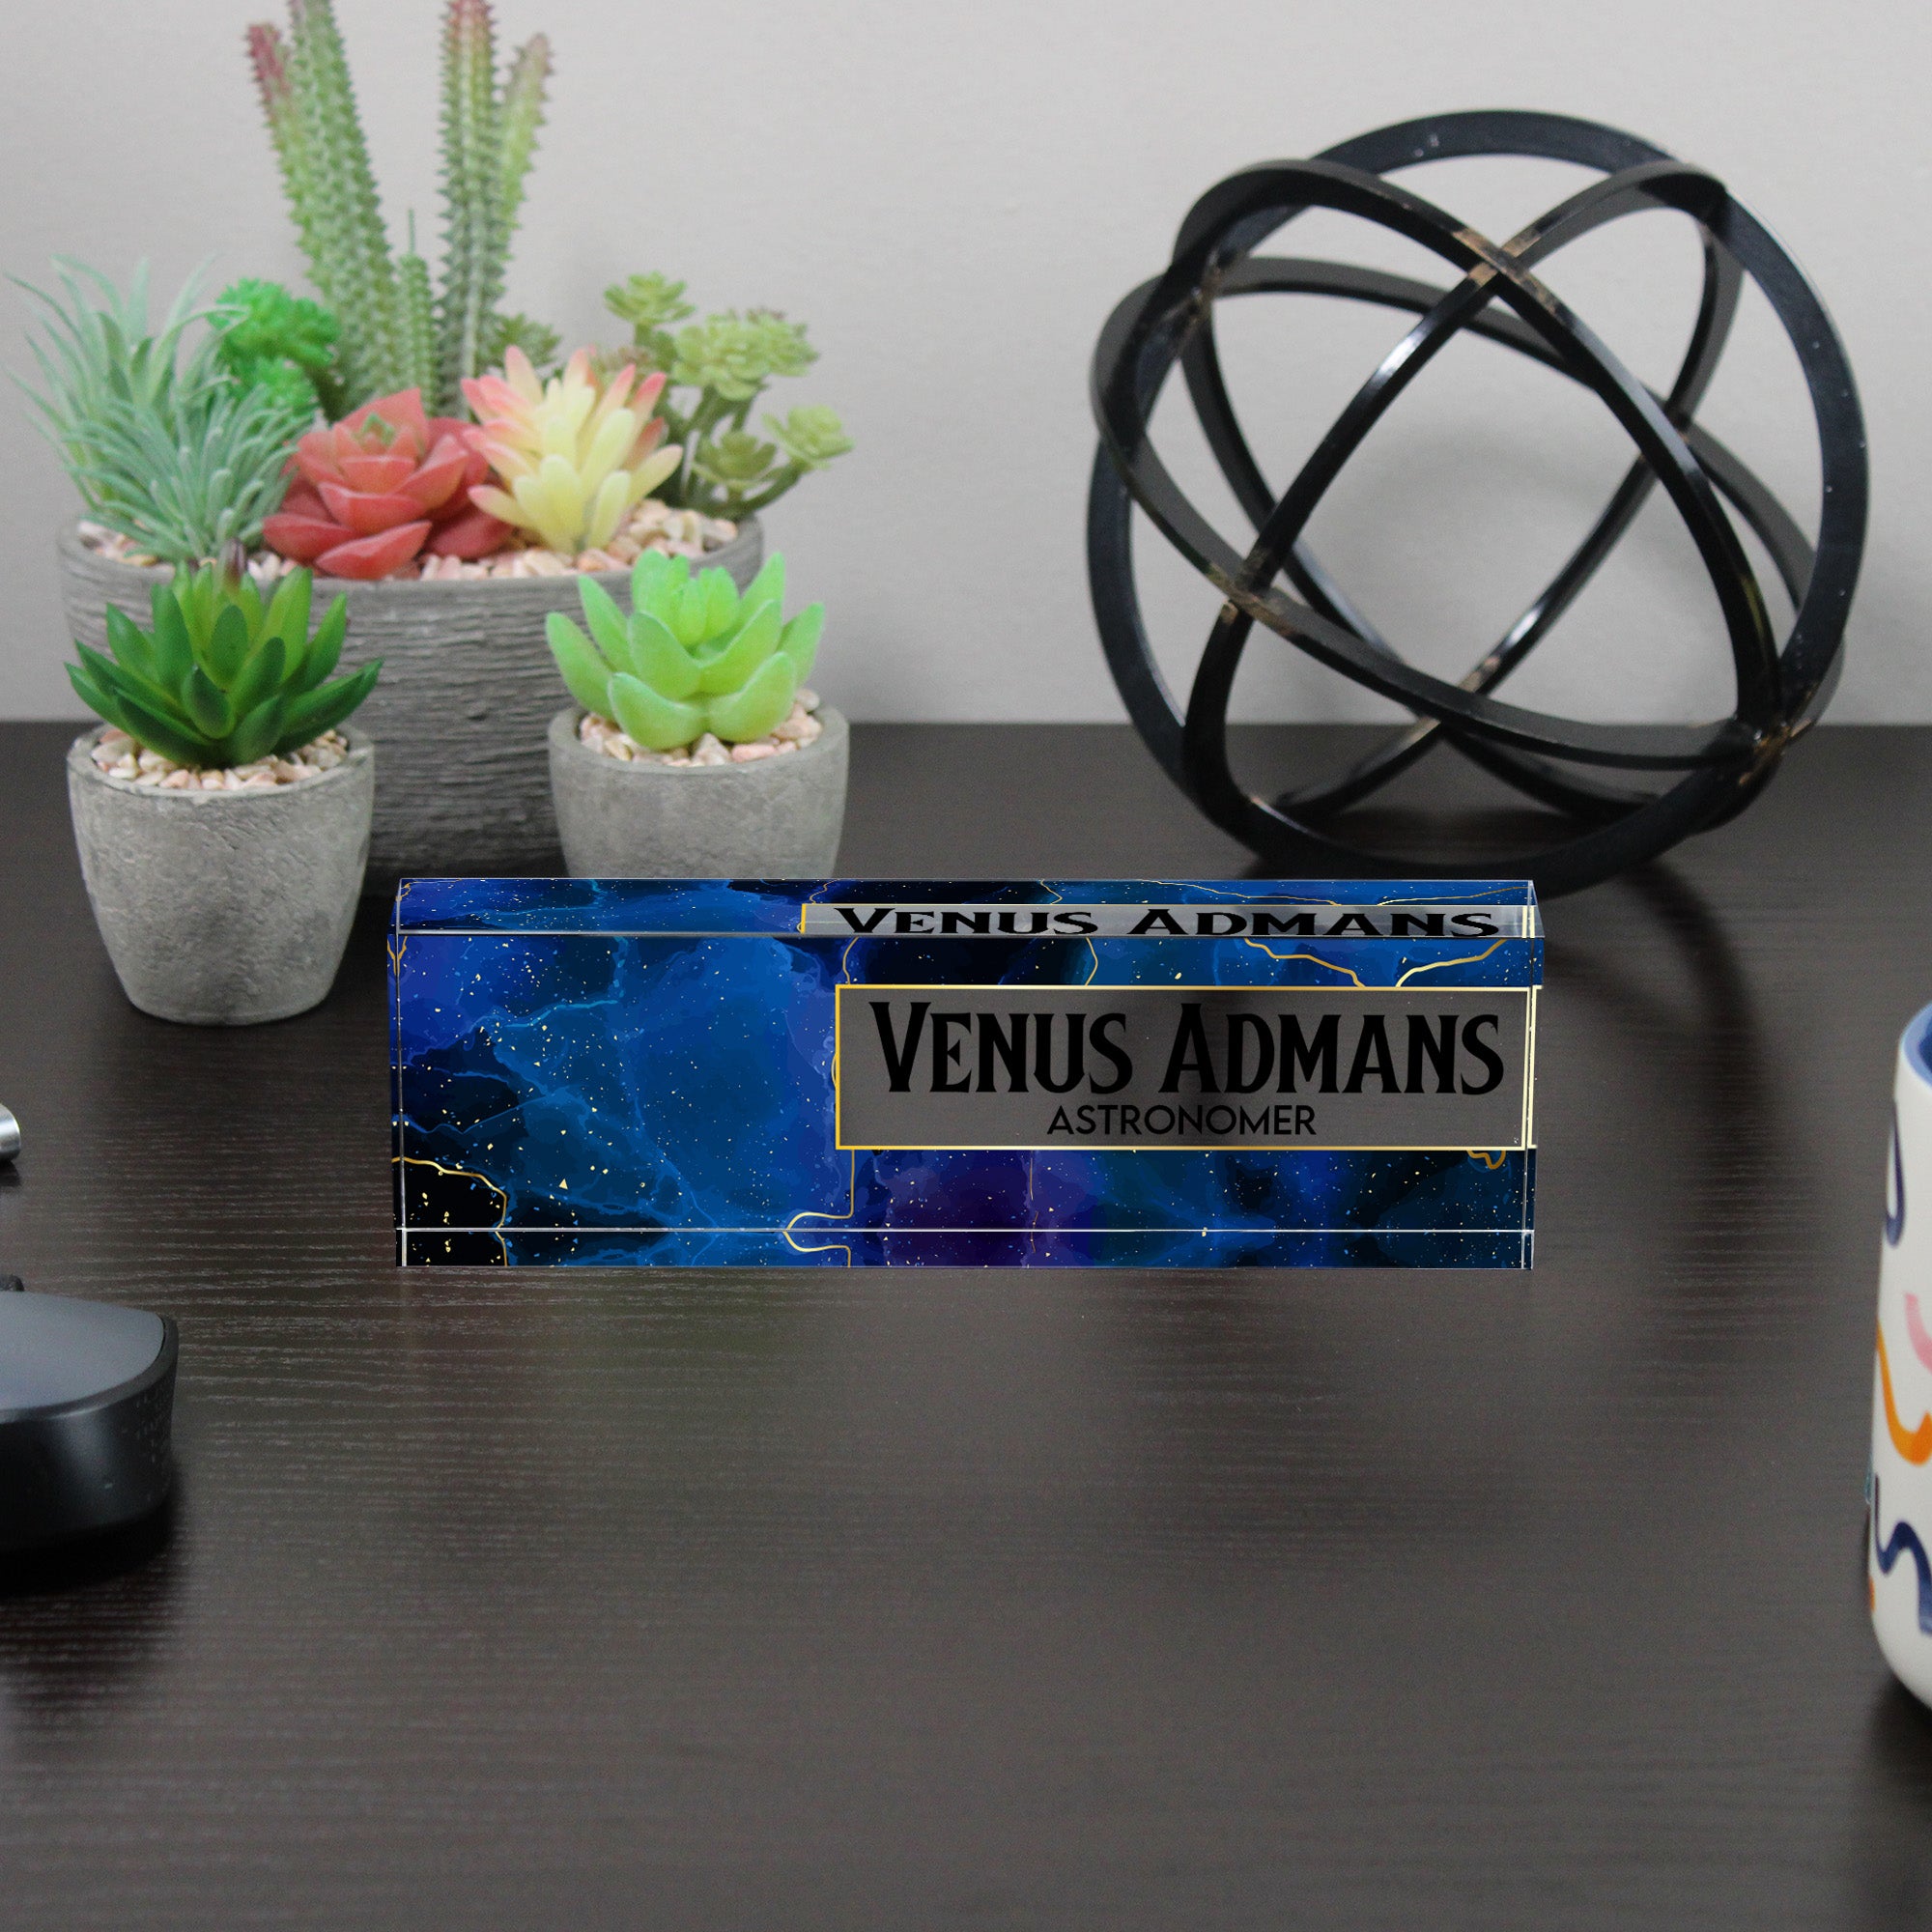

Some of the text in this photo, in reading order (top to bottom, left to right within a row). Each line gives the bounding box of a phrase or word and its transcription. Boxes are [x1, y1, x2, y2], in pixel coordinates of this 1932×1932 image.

[835, 907, 1500, 937] VENUS ADMANS
[868, 1001, 1505, 1095] VENUS ADMANS
[1047, 1105, 1317, 1136] ASTRONOMER
